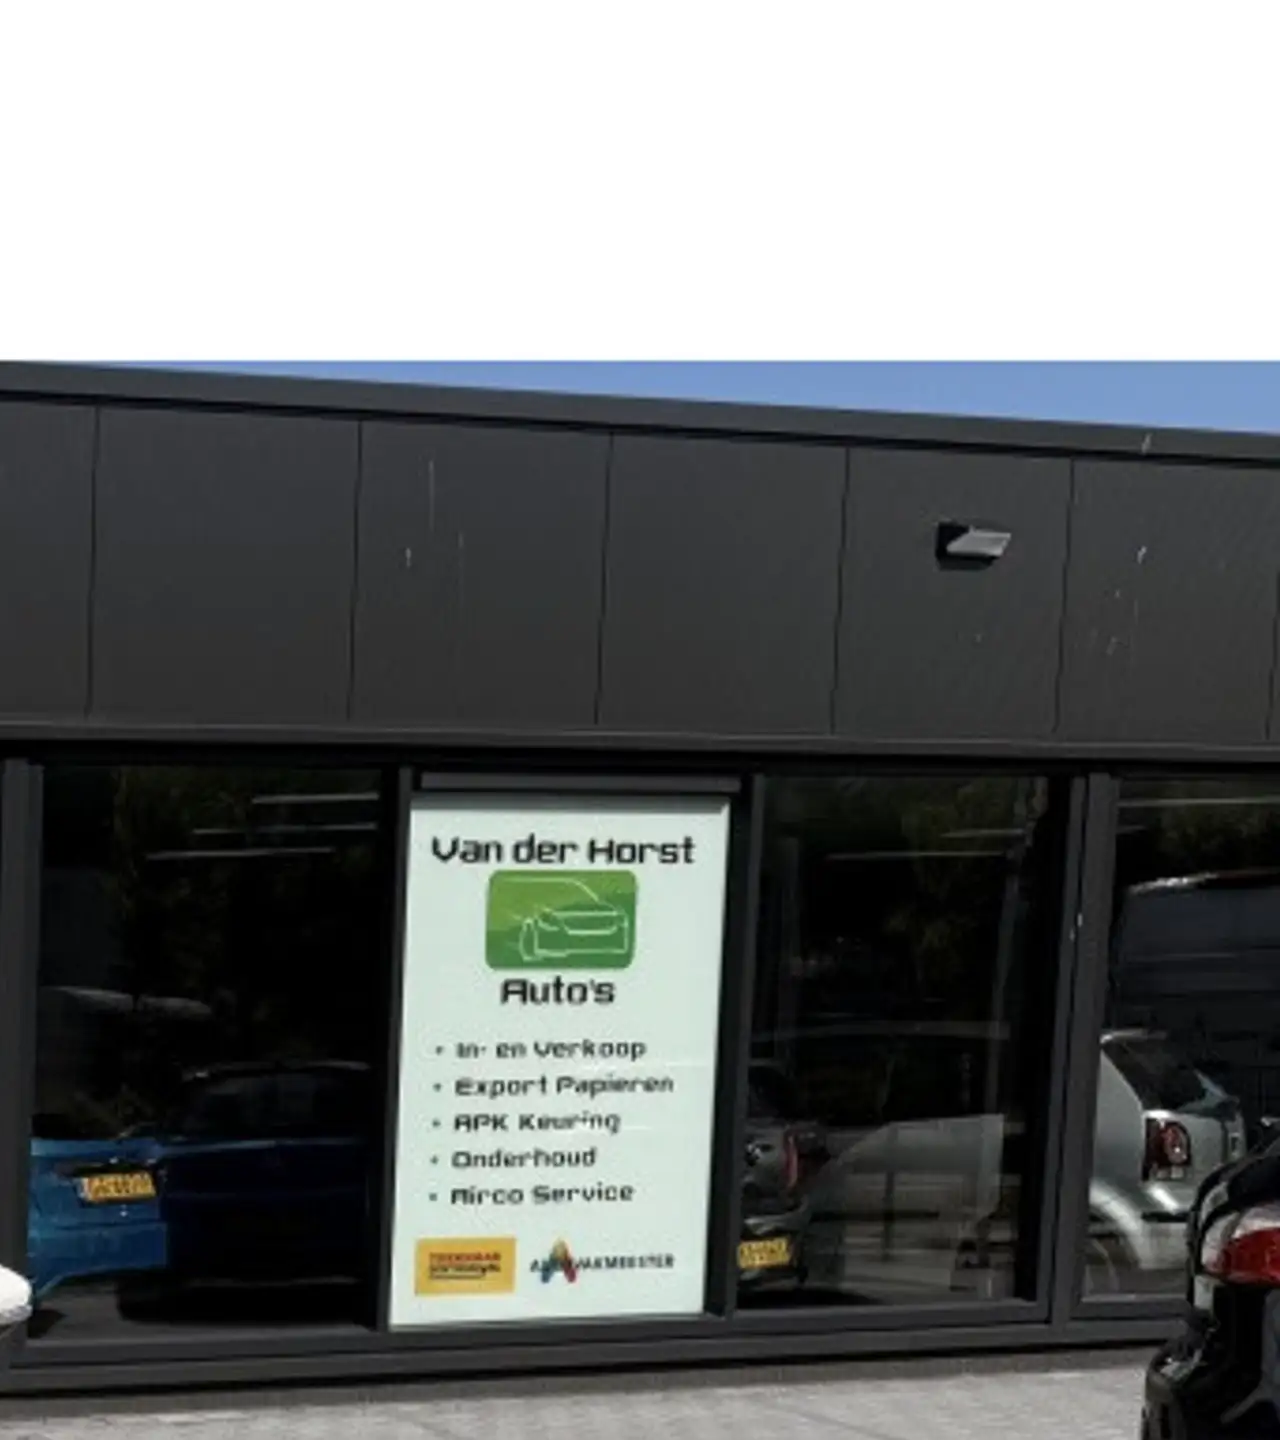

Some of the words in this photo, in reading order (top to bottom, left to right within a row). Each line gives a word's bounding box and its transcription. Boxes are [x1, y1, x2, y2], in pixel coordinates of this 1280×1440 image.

[432, 838, 503, 863] Van
[513, 834, 577, 863] der
[588, 837, 694, 863] Horst
[501, 976, 614, 1004] Auto's
[457, 1043, 486, 1058] In-
[496, 1043, 526, 1058] en
[534, 1040, 645, 1061] Verkoop
[455, 1076, 547, 1099] Export
[556, 1076, 673, 1099] Papieren
[455, 1114, 506, 1132] APK
[519, 1112, 620, 1134] Keuring
[452, 1148, 596, 1168] Onderhoud
[451, 1186, 524, 1204] Airco
[532, 1182, 633, 1203] Service
